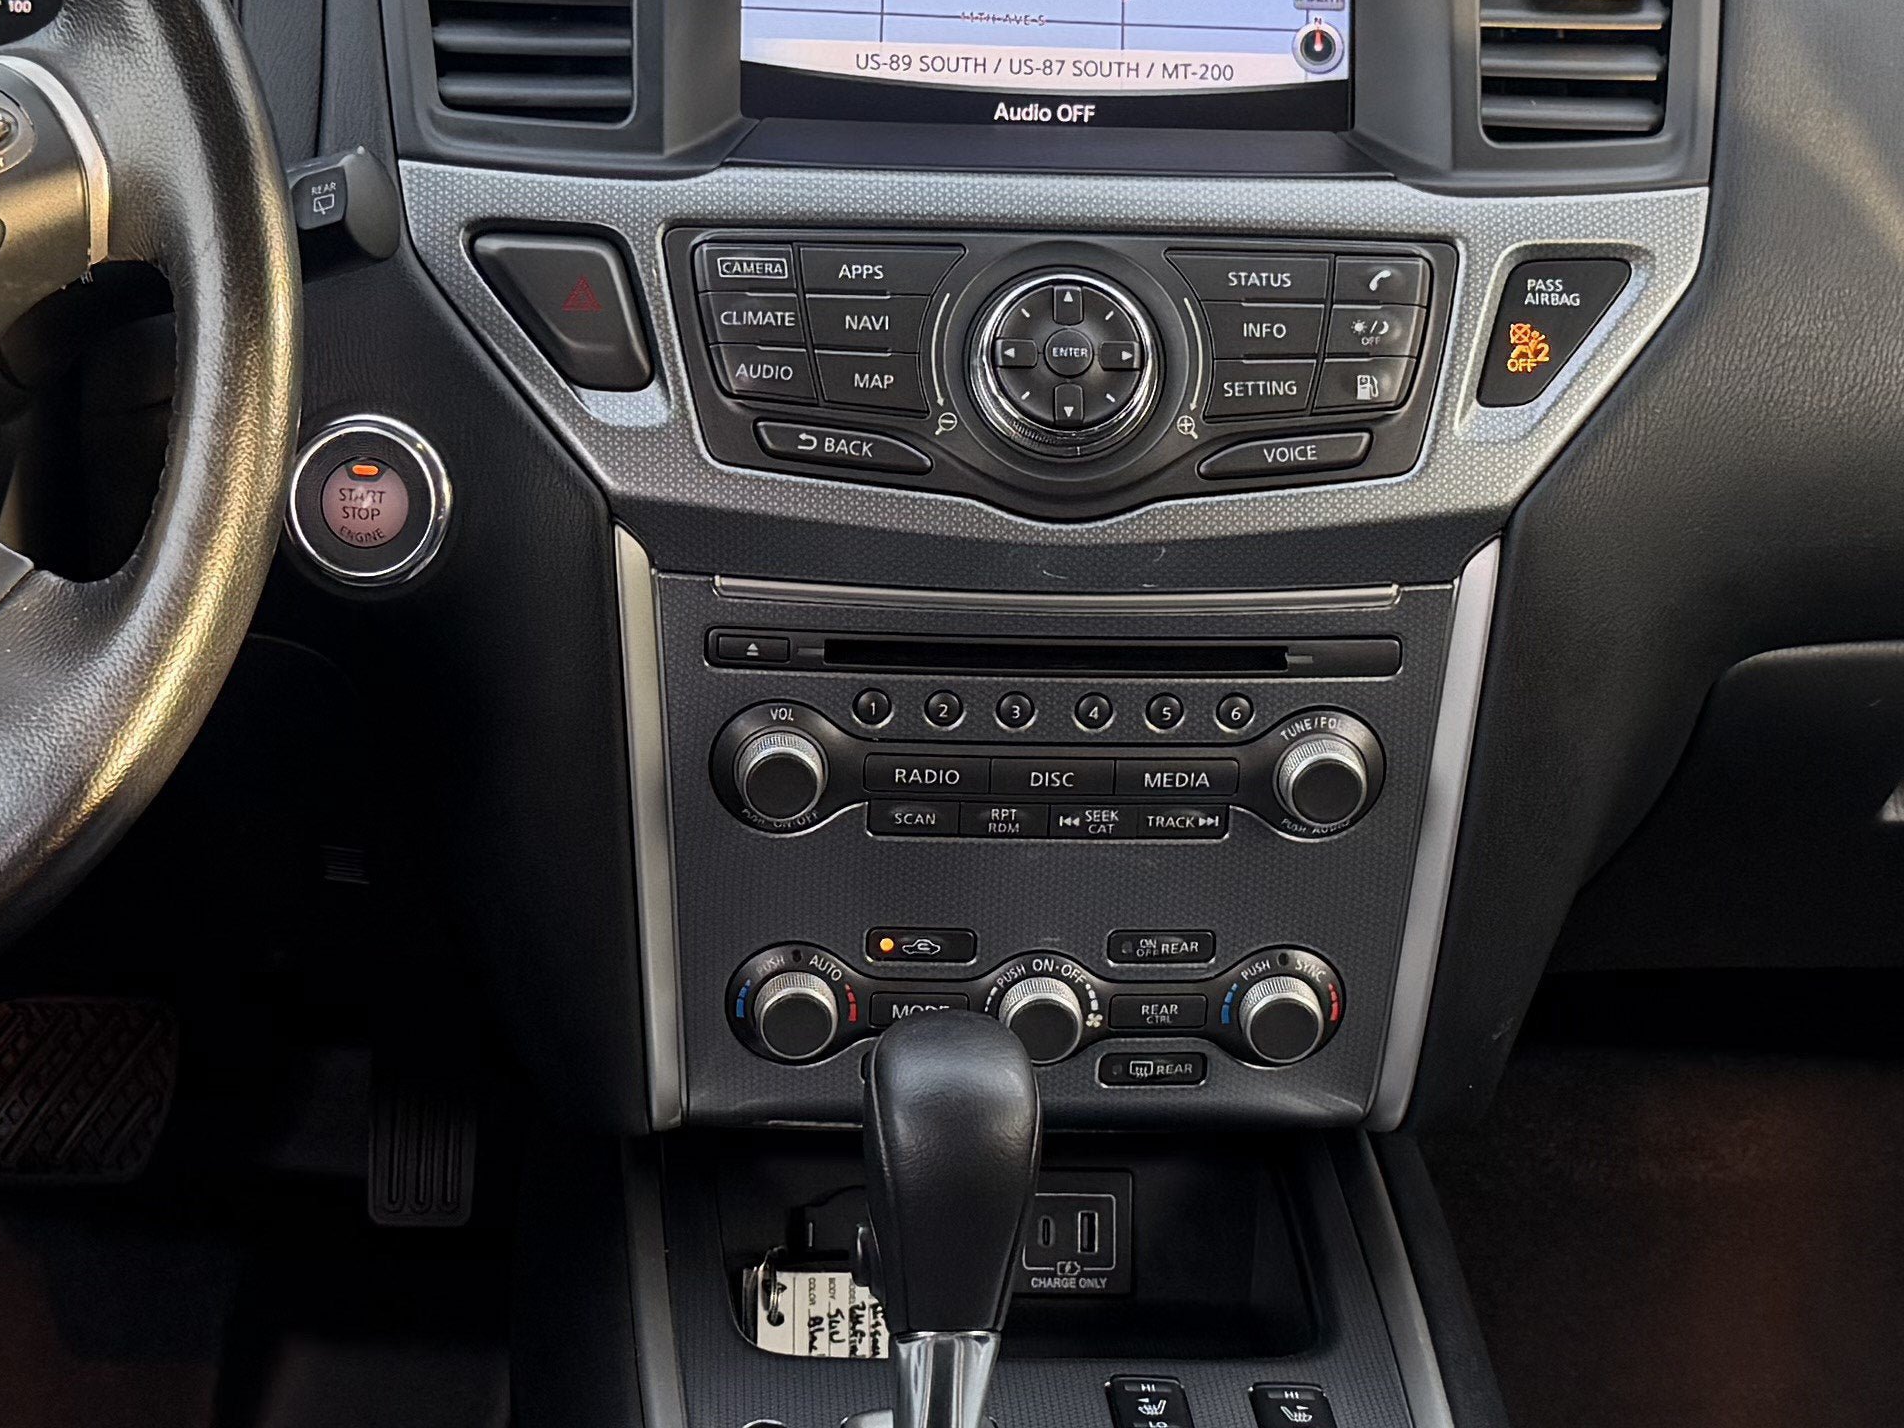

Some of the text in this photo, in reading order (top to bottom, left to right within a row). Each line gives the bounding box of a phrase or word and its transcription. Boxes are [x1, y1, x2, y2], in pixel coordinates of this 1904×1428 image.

[8, 0, 32, 13] 100
[855, 53, 1234, 81] US-89 SOUTH / US-87 SOUTH / MT-200
[994, 102, 1095, 122] Audio OFF
[311, 182, 337, 196] REAR
[722, 261, 783, 274] CAMERA
[839, 265, 884, 280] APPS
[1228, 272, 1291, 288] STATUS
[1527, 278, 1563, 292] PASS
[1524, 293, 1581, 306] AIRBAG
[720, 311, 796, 327] CLIMATE
[845, 315, 889, 330] NAVI
[1243, 322, 1287, 338] INFO
[1361, 335, 1380, 346] OFF
[1052, 346, 1088, 358] ENTER
[736, 363, 793, 380] AUDIO
[1507, 358, 1538, 372] OFF
[854, 373, 894, 389] MAP
[1223, 380, 1297, 397] SETTING
[824, 437, 873, 458] BACK
[1264, 445, 1317, 462] VOICE
[338, 487, 387, 504] START
[341, 506, 381, 521] STOP
[339, 526, 386, 545] ENGINE
[770, 707, 794, 721] VOL
[870, 701, 876, 716] 1
[938, 704, 949, 718] 2
[1011, 705, 1020, 719] 3
[1088, 706, 1099, 720] 4
[1162, 706, 1171, 720] 5
[1231, 706, 1241, 720] 6
[895, 768, 960, 784] RADIO
[1030, 771, 1074, 787] DISC
[1144, 772, 1210, 788] MEDIA
[894, 813, 935, 825] SCAN
[991, 808, 1017, 821] RPT
[1085, 810, 1119, 822] SEEK
[1148, 815, 1195, 828] TRACK
[988, 822, 1020, 833] RDM
[1088, 823, 1114, 834] CAT
[1161, 941, 1199, 954] REAR
[755, 954, 842, 981] PUSH AUTO
[1241, 959, 1327, 983] PUSH SYNC
[996, 964, 1026, 988] PUSH
[1141, 1004, 1178, 1016] REAR
[1156, 1063, 1193, 1075] REAR
[1031, 1276, 1108, 1290] CHARGE ONLY
[1140, 1383, 1156, 1392] HI
[1284, 1391, 1299, 1399] HI
[1149, 1421, 1168, 1428] LO
